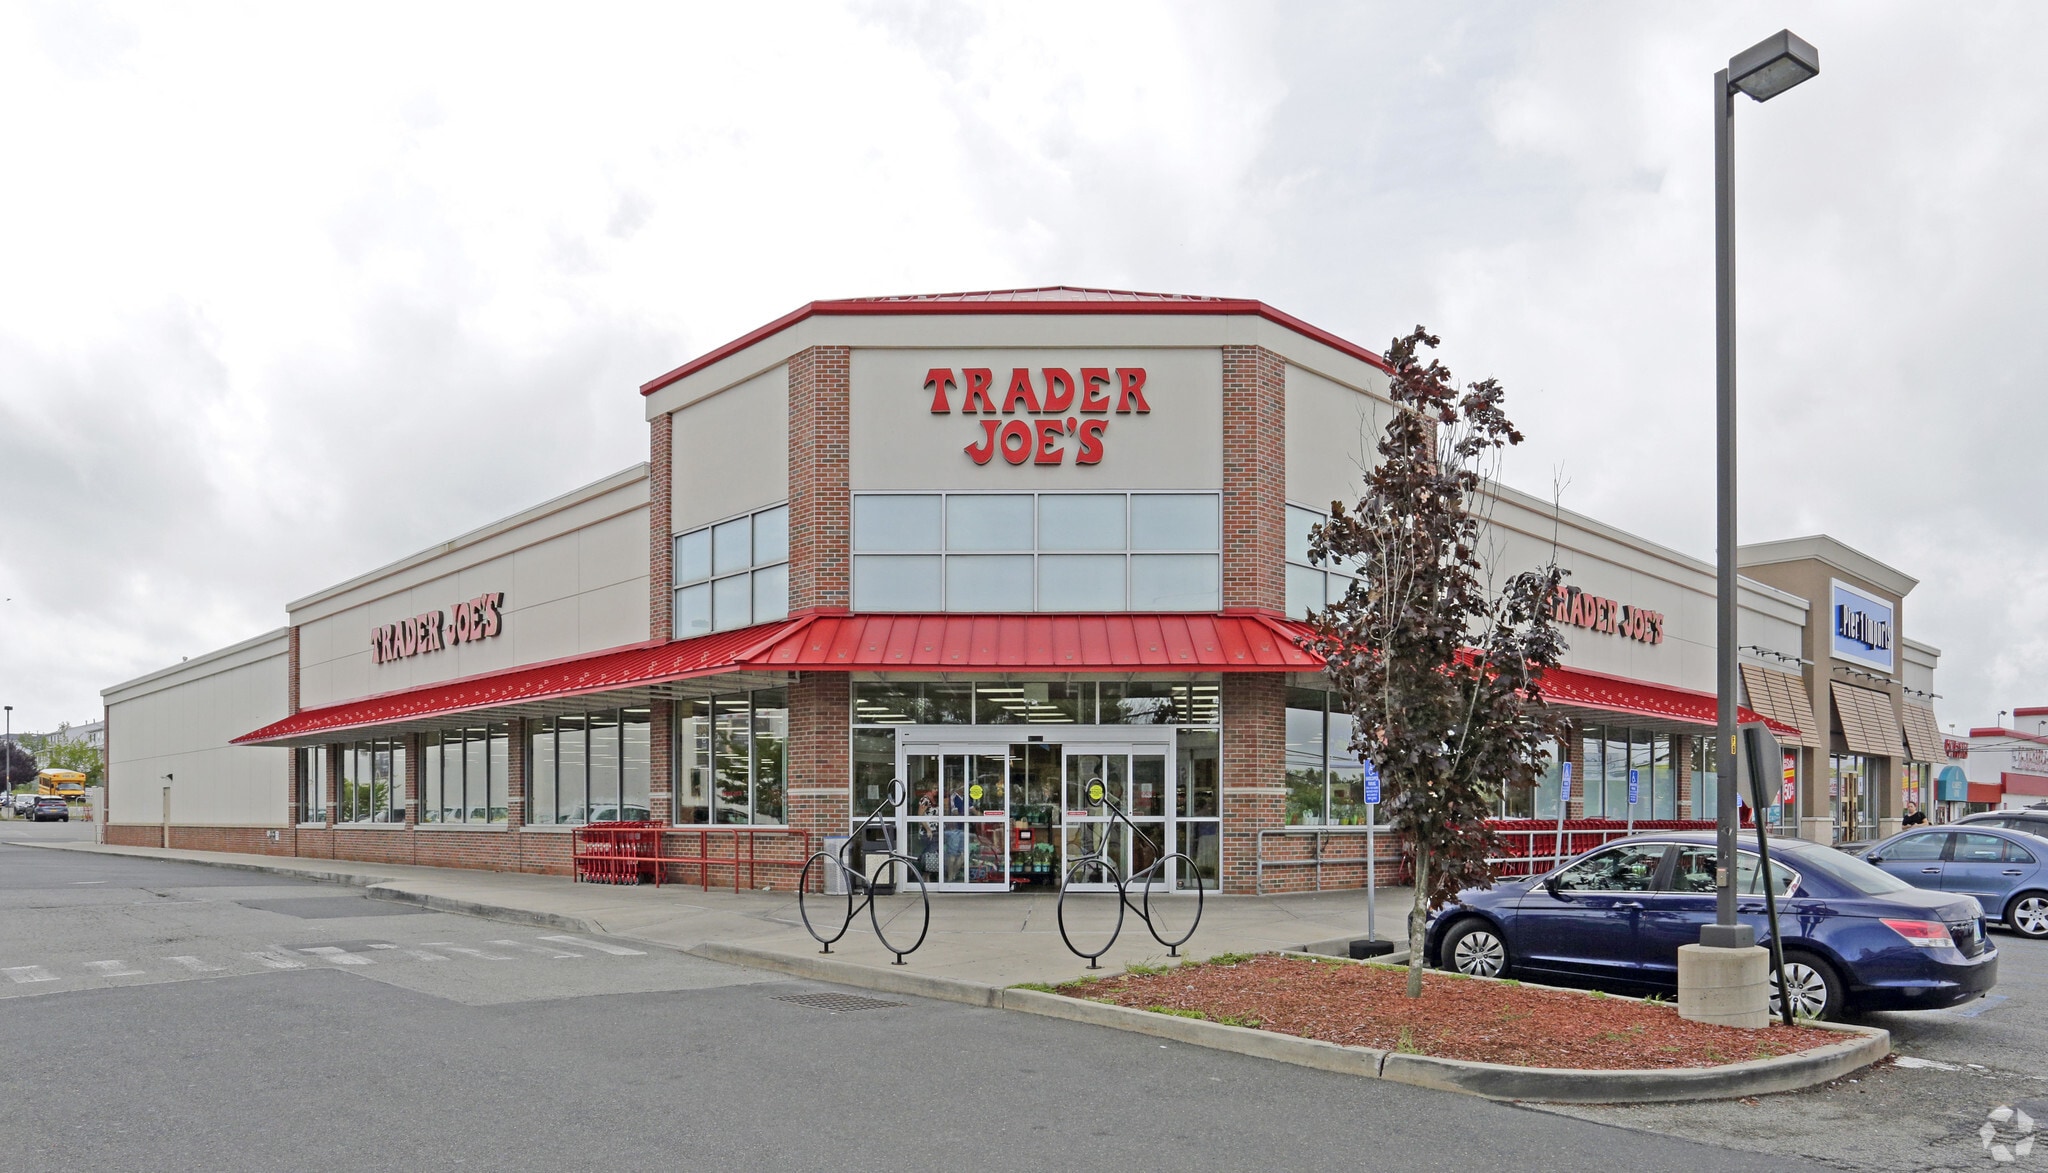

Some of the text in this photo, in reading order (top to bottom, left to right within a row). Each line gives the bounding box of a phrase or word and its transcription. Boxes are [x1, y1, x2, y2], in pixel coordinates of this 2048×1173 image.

[923, 367, 1151, 414] TRADER
[963, 416, 1109, 466] JOE'S
[370, 592, 504, 665] TRADER JOE'S
[1545, 585, 1664, 645] RADER JOE'S
[1840, 604, 1860, 640] Pier
